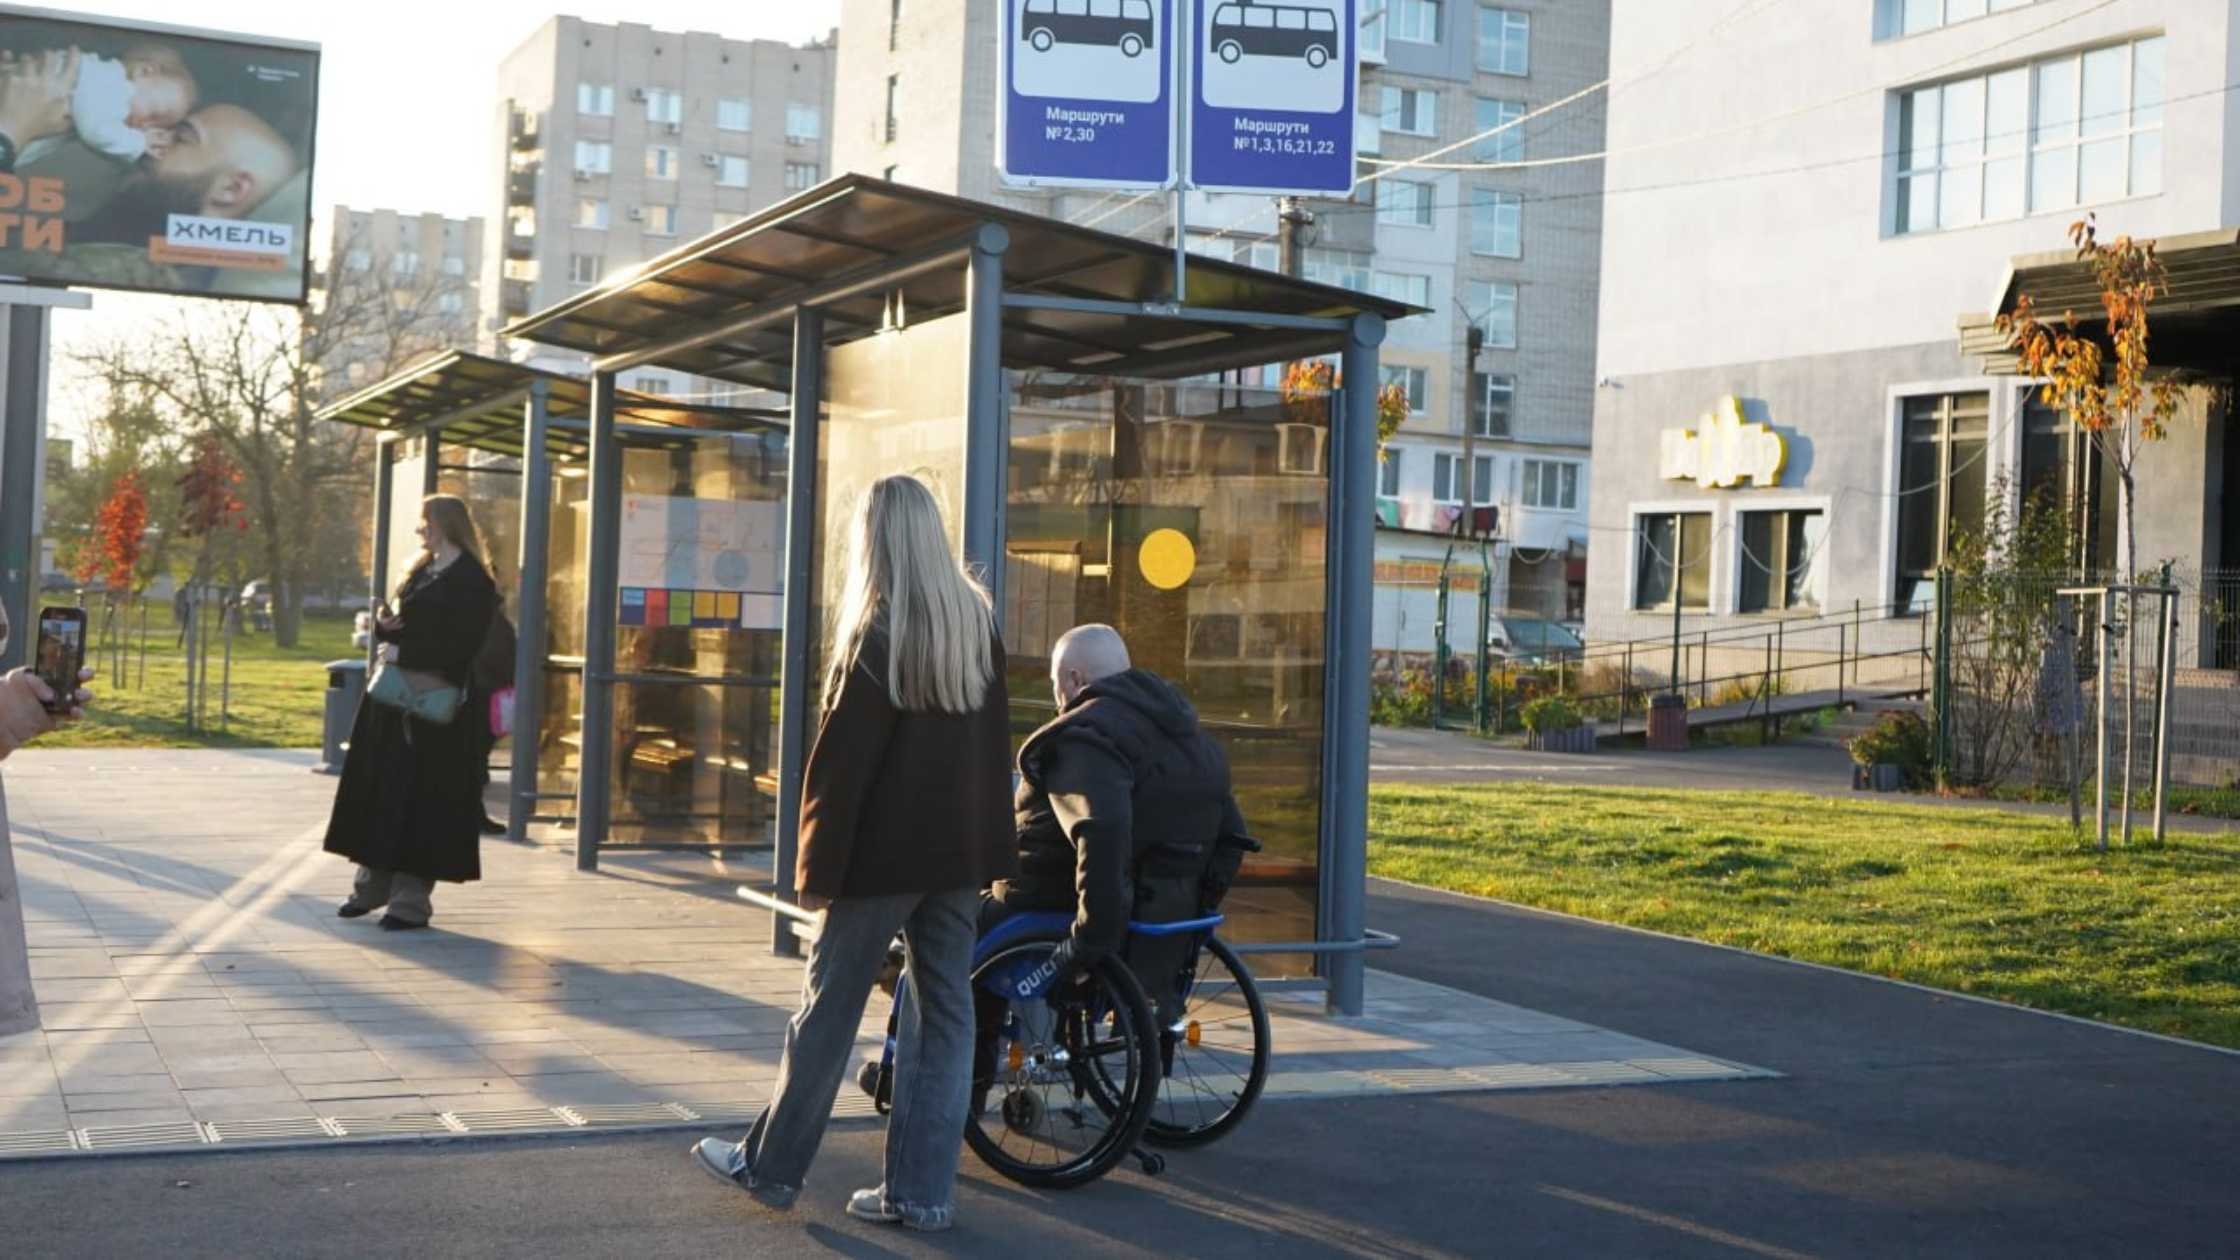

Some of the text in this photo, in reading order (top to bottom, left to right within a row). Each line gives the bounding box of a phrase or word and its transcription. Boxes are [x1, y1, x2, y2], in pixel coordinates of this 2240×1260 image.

[1046, 106, 1124, 126] Маршрути
[1234, 117, 1310, 136] Маршрути
[174, 221, 286, 246] ХМЕЛЬ
